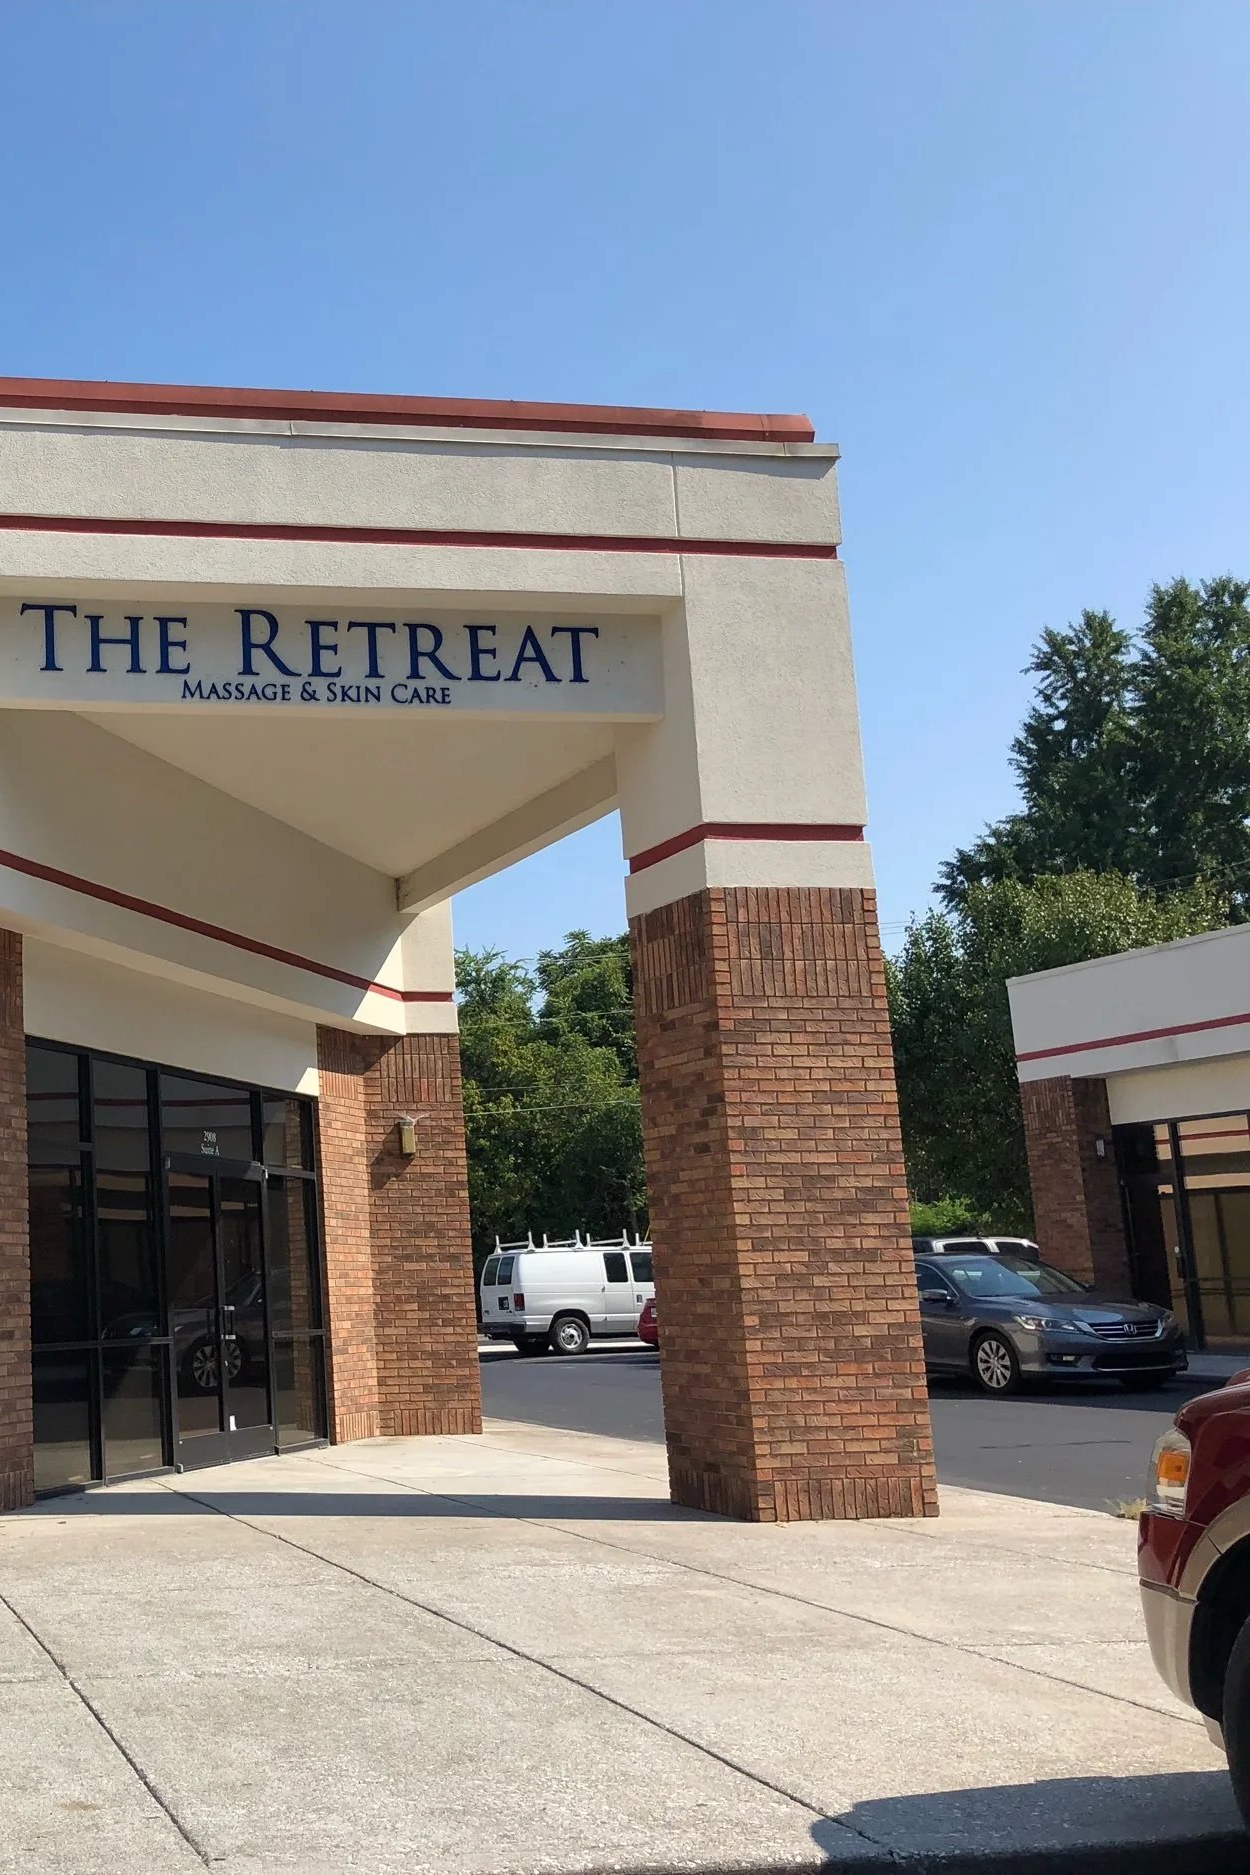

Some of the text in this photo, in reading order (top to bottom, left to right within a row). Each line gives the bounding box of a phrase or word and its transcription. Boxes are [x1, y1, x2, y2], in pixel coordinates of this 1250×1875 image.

[20, 602, 599, 686] THE RETREAT
[181, 679, 452, 706] MASSAGE & SKIN CARE
